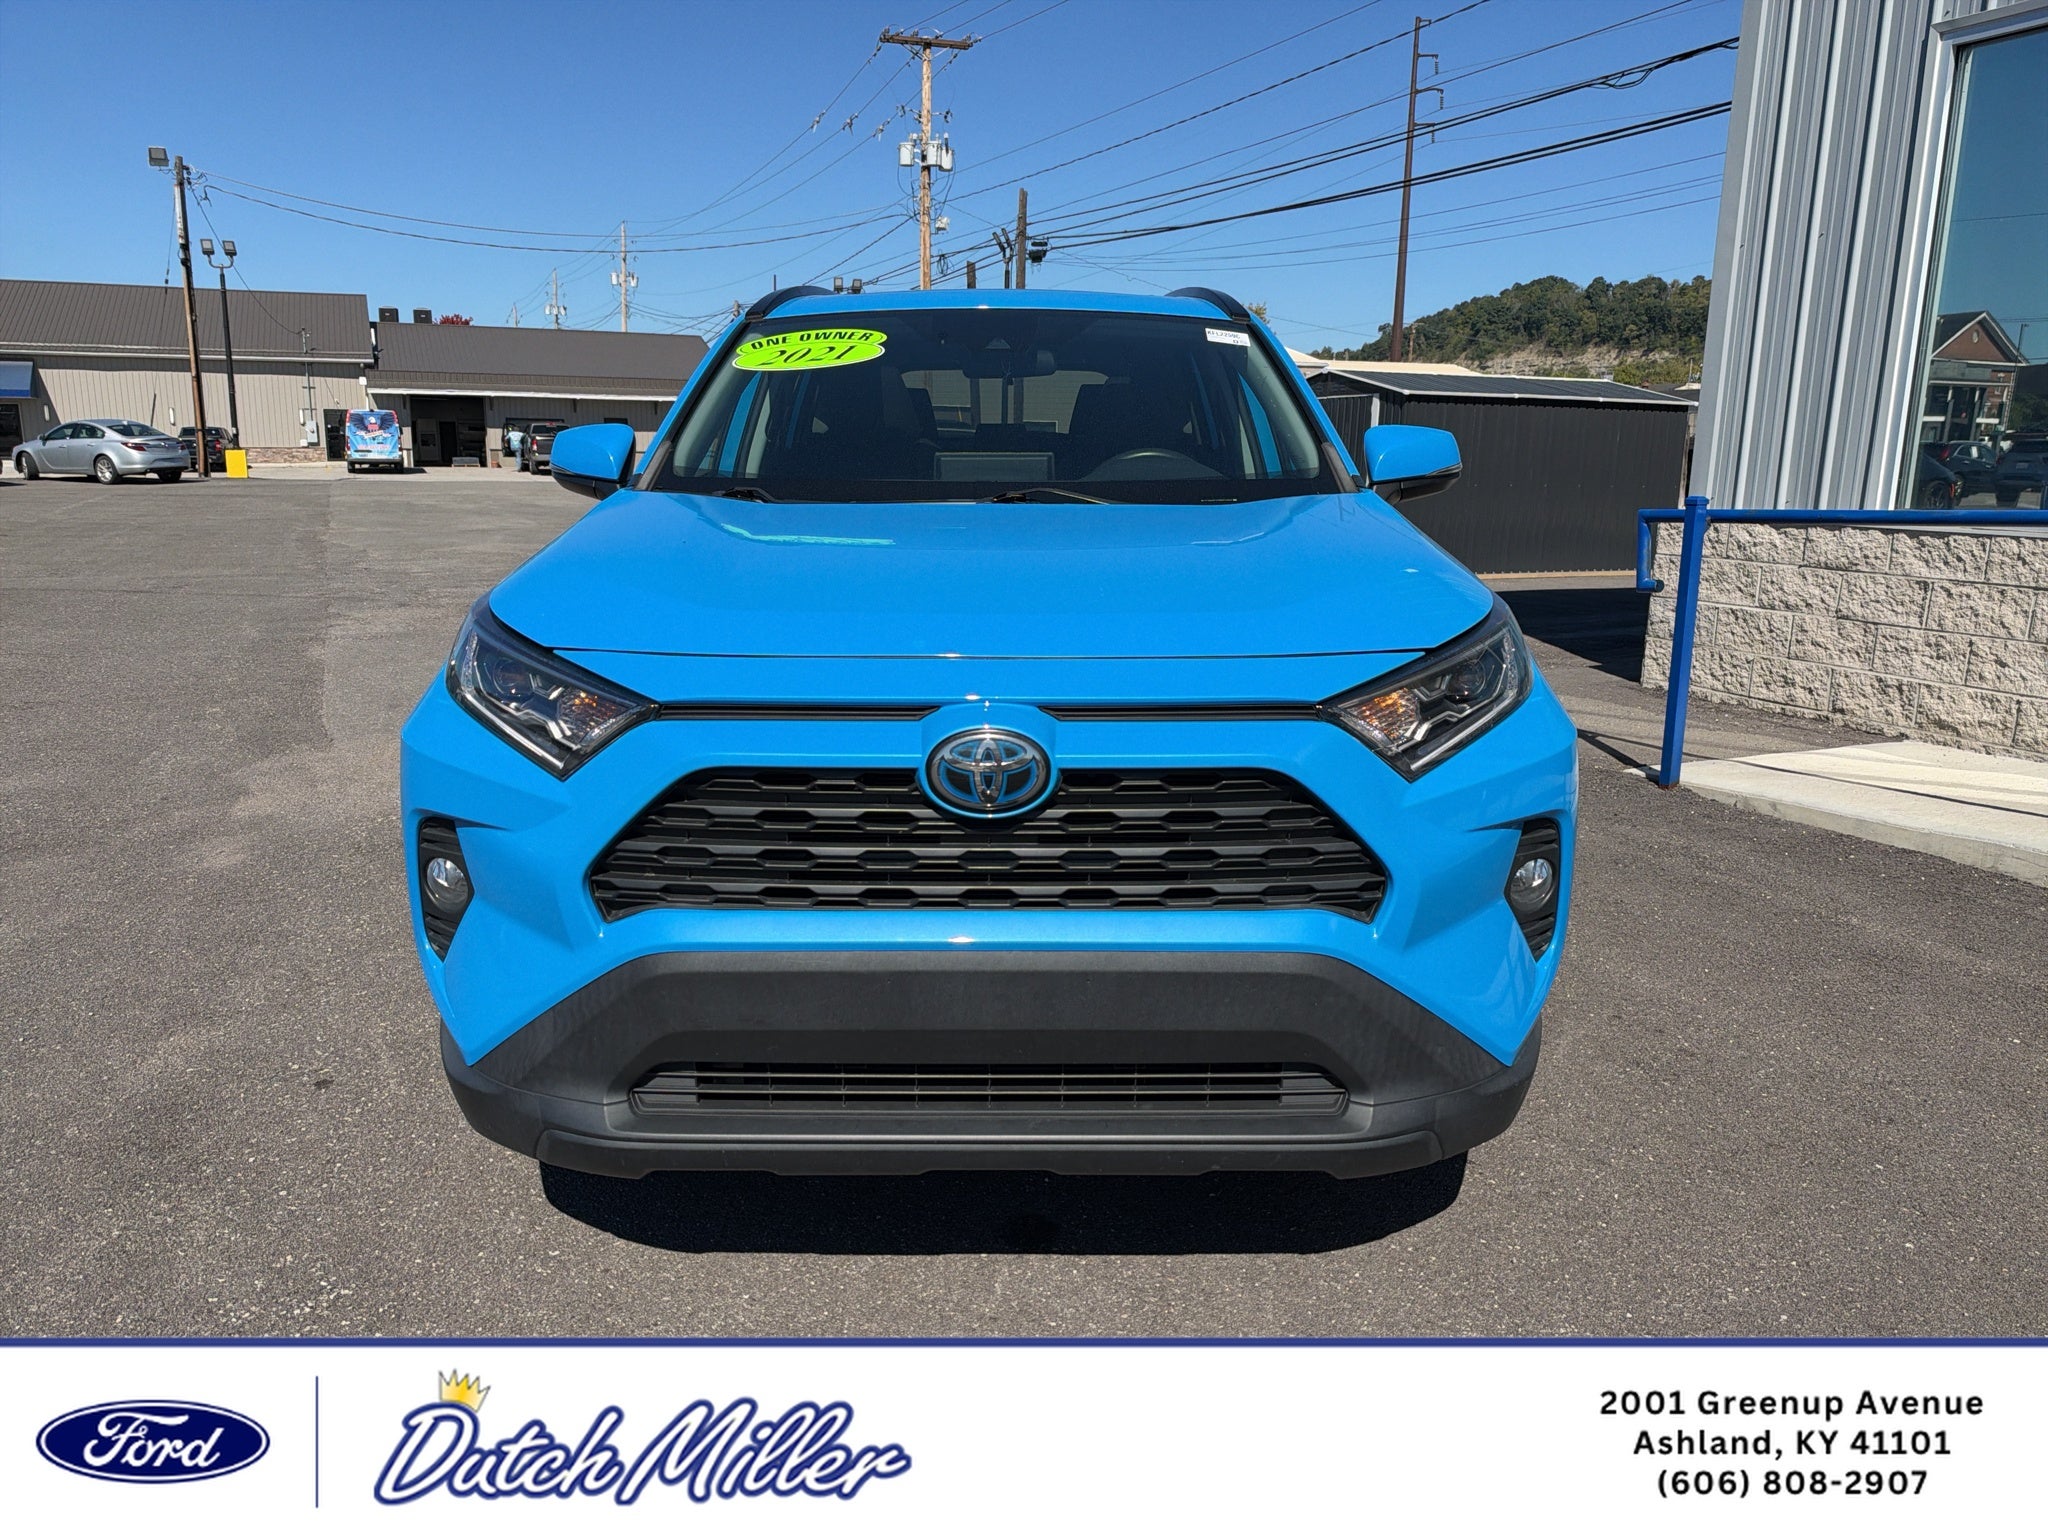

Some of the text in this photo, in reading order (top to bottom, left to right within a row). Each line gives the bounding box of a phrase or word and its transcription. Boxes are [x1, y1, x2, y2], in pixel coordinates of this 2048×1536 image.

[751, 331, 874, 350] ONE OWNER
[757, 344, 858, 366] 2021
